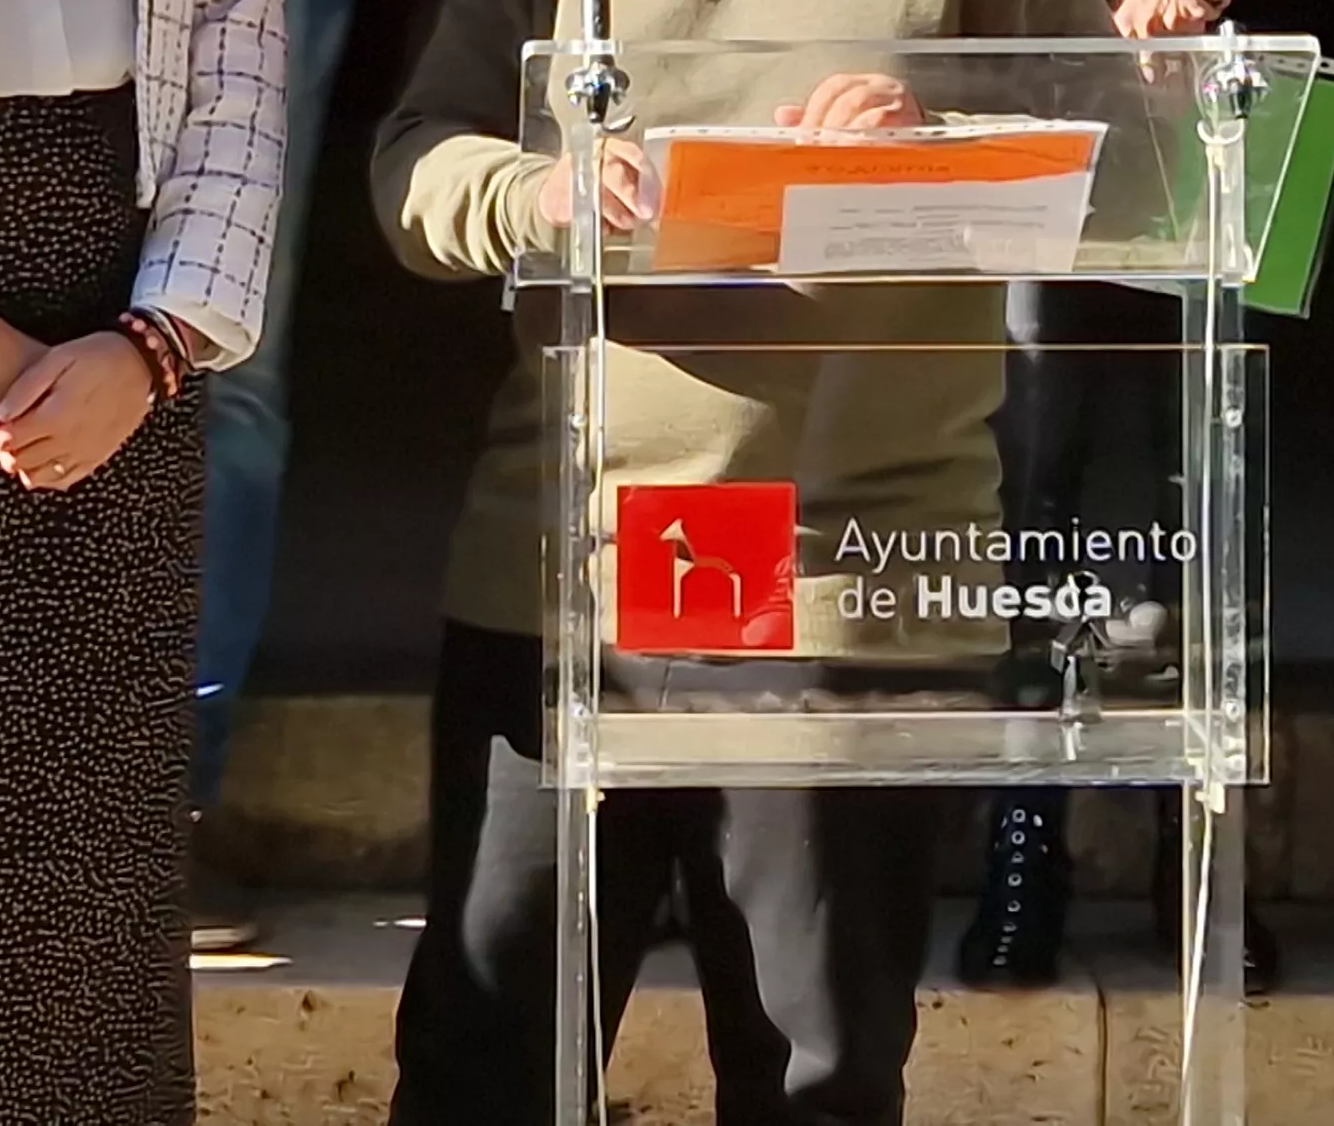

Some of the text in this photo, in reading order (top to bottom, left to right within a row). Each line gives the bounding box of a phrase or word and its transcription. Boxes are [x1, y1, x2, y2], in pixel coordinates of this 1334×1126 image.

[834, 517, 1197, 574] Ayuntamiento
[837, 576, 1112, 619] de Huesca
